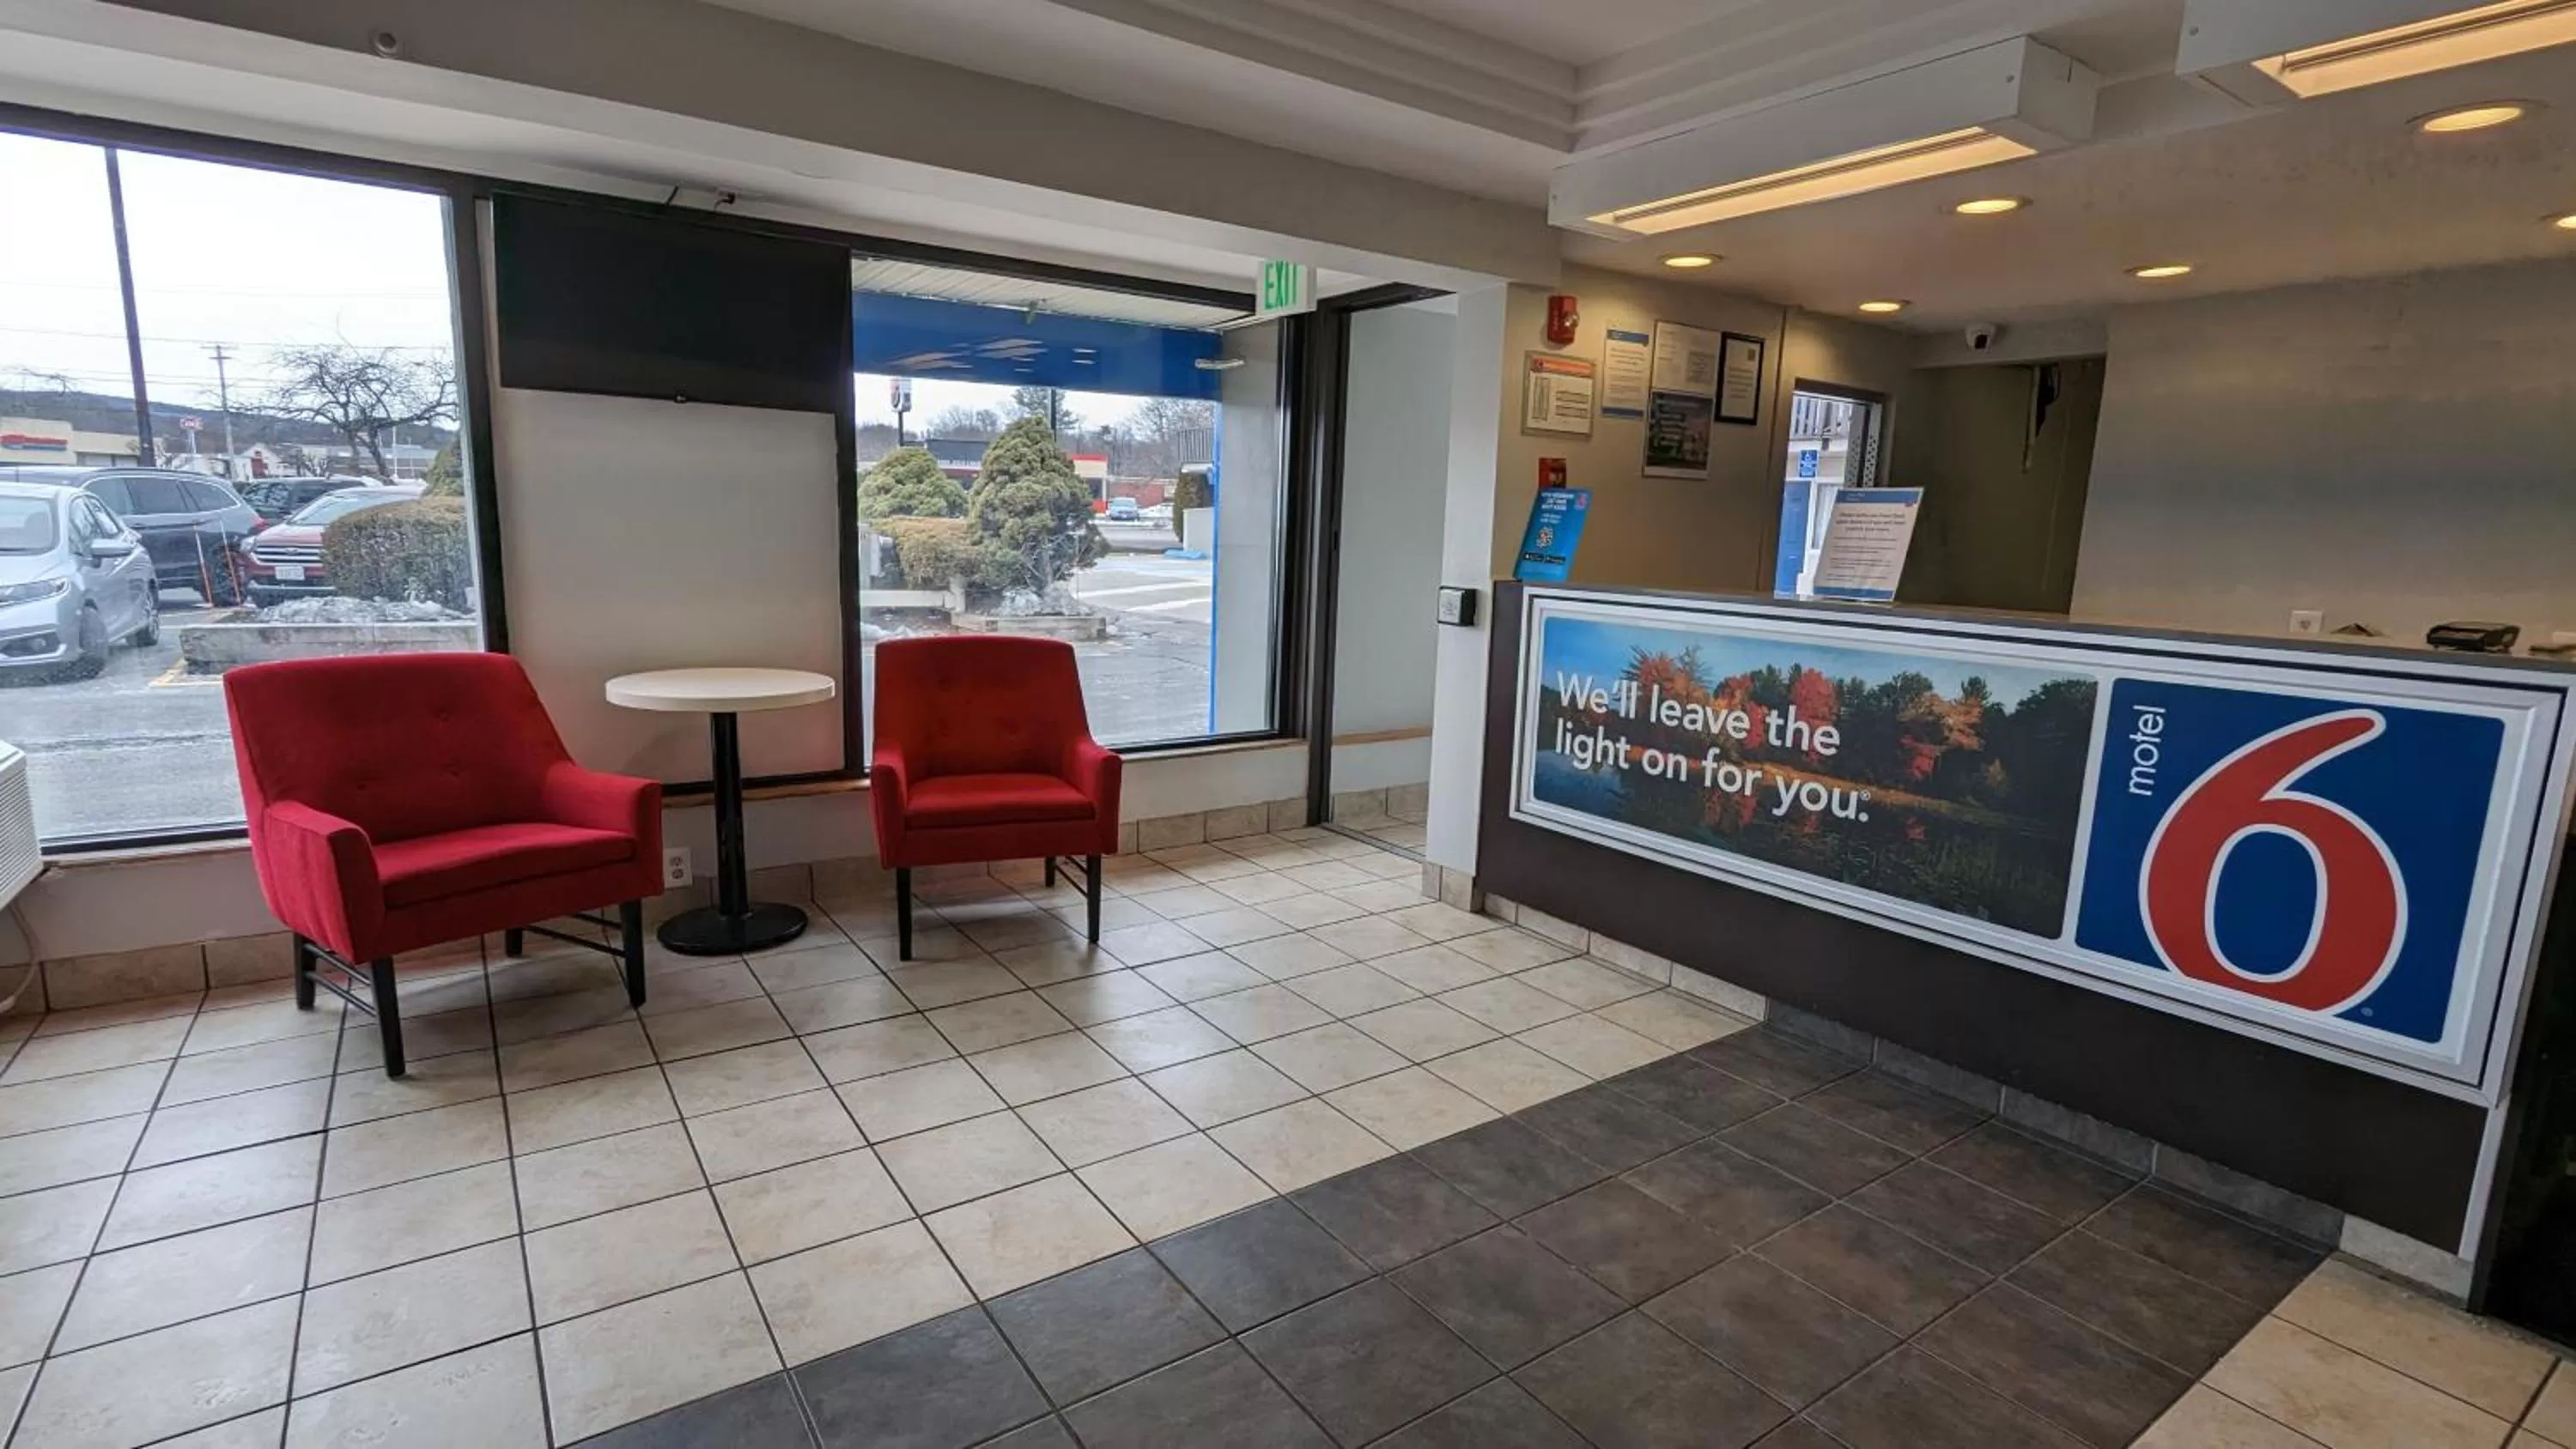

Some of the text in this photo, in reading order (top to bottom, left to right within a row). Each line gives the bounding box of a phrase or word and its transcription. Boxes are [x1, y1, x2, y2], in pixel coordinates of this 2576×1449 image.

[1557, 671, 1840, 755] We'll leave the
[1555, 718, 1631, 770] light
[1642, 749, 1687, 782] on
[1701, 747, 1762, 797] for
[2129, 705, 2409, 1016] motel 6
